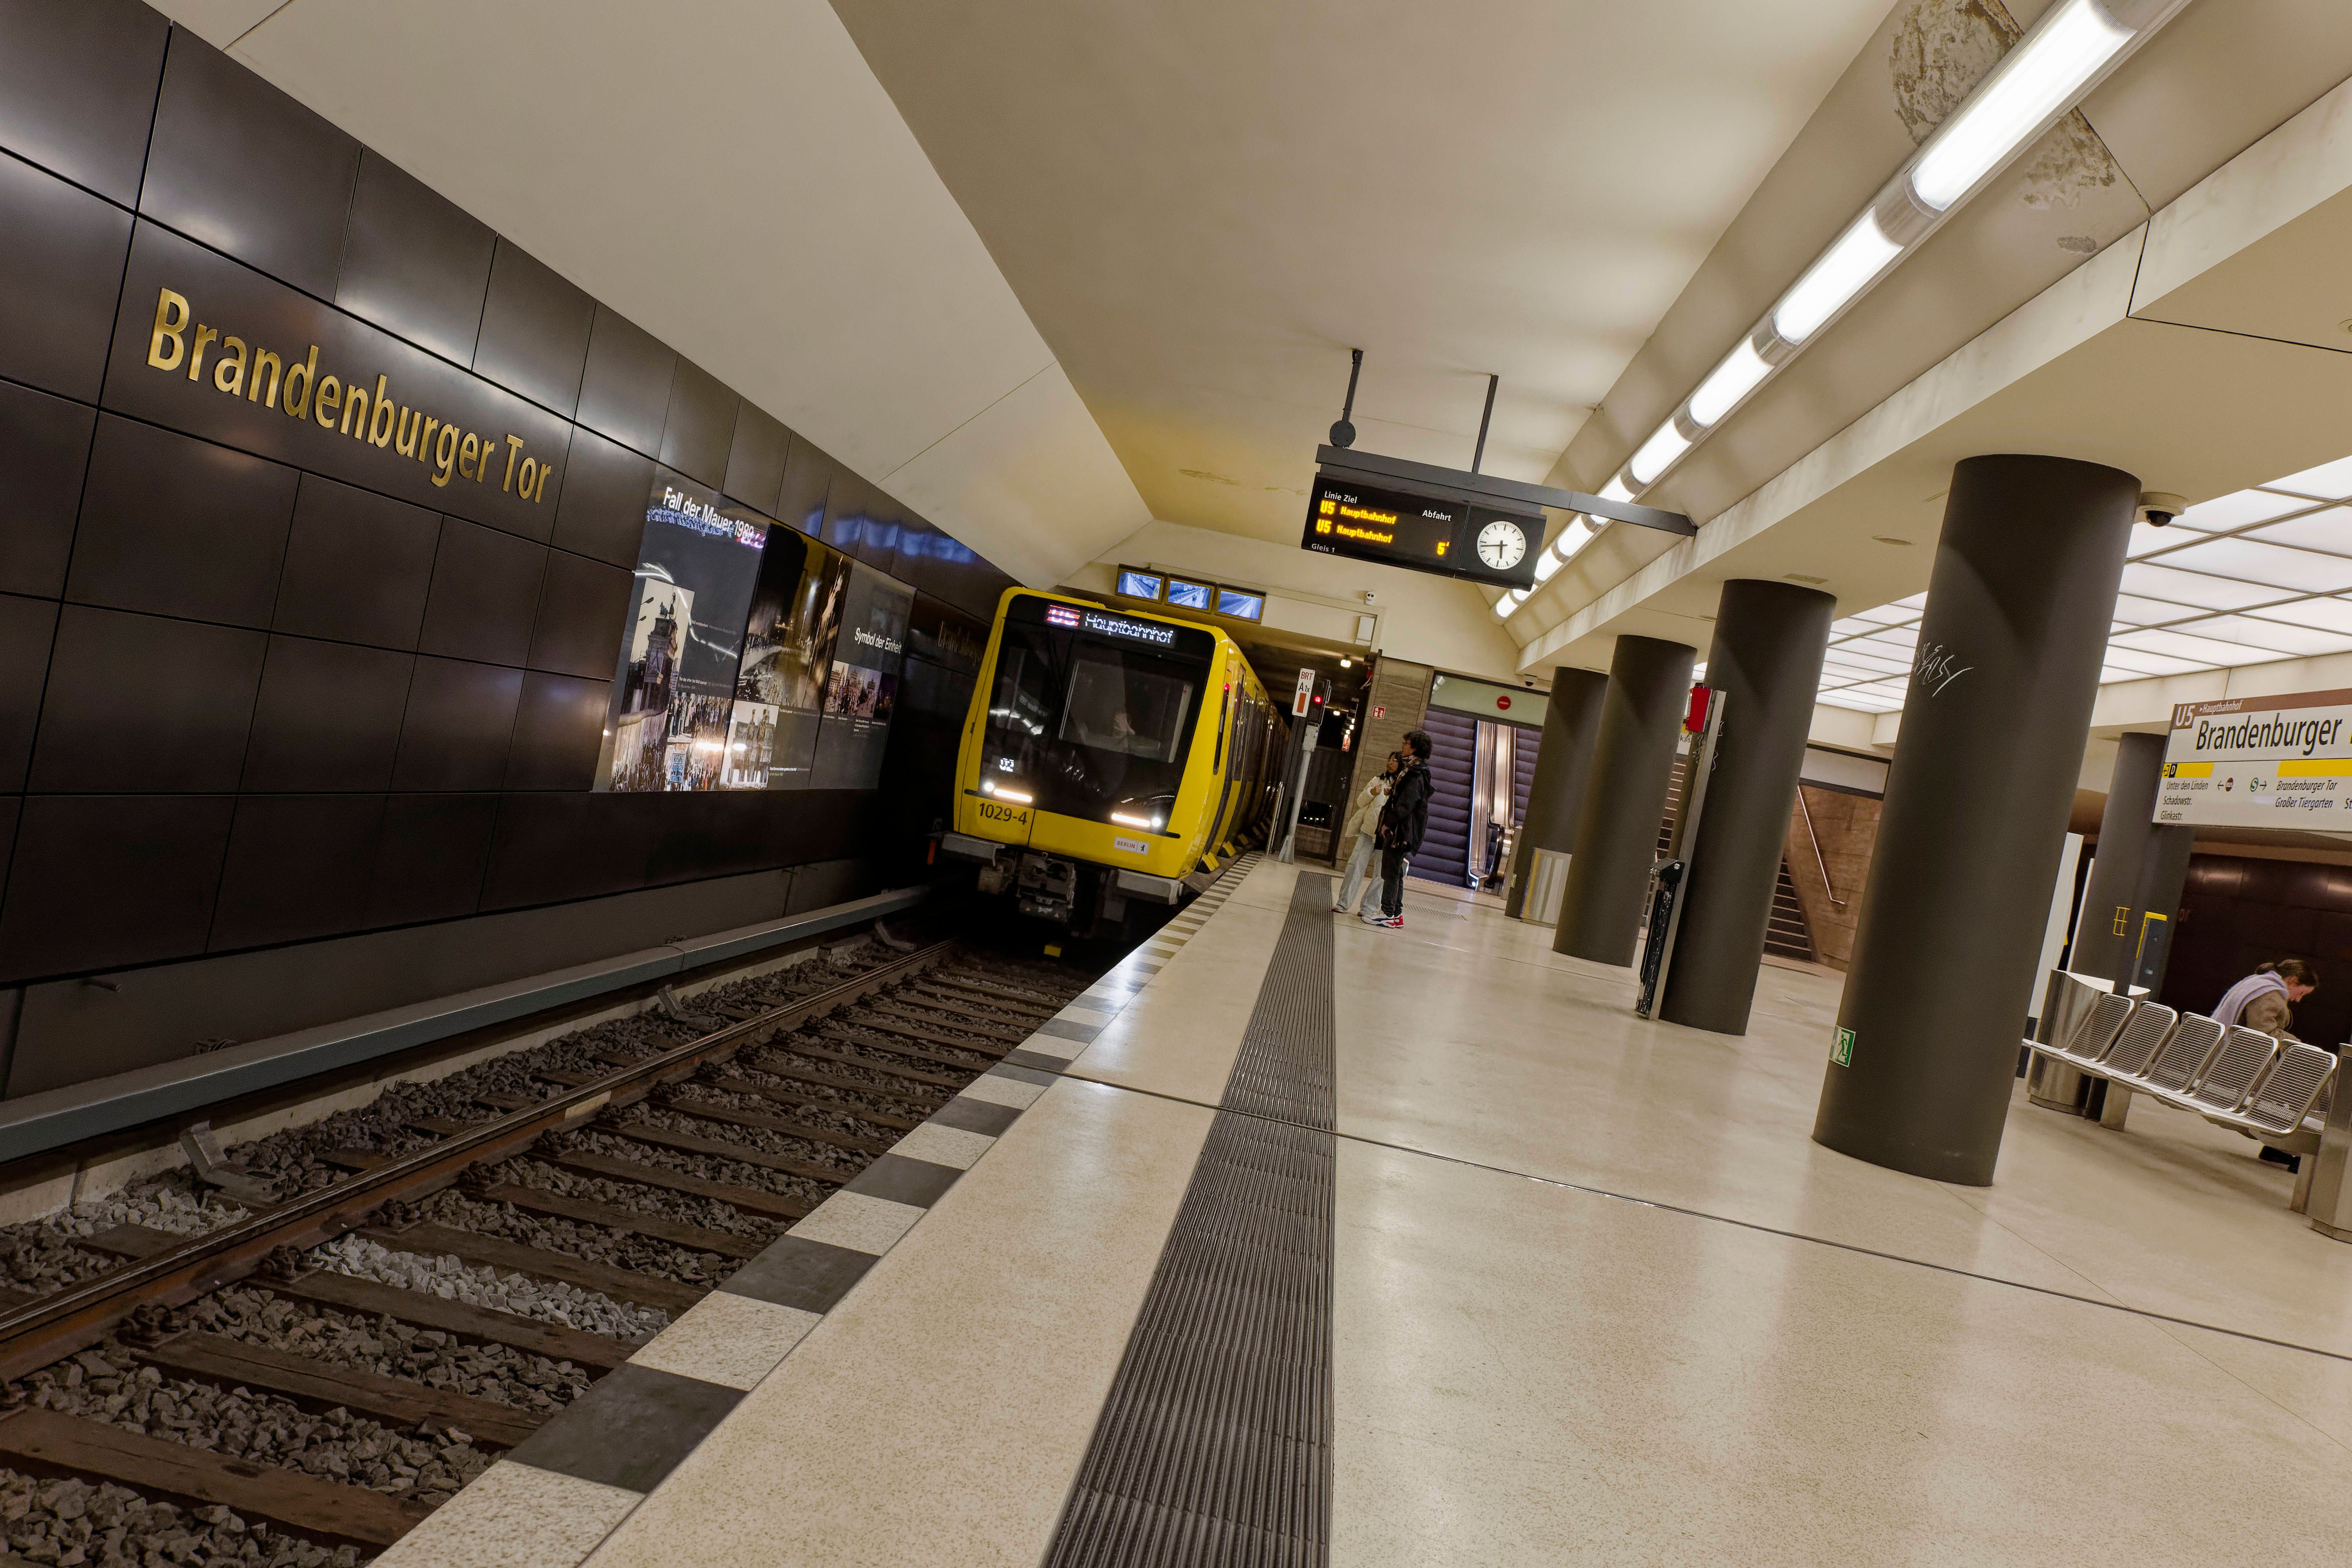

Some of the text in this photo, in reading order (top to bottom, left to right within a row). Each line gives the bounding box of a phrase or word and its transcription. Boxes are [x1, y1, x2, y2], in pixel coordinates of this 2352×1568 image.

[147, 287, 551, 504] Brandenburger Tor
[1324, 491, 1357, 504] Linie Ziel
[663, 486, 683, 511] Fall
[683, 497, 701, 518] der
[702, 504, 733, 532] Mauer
[1320, 500, 1397, 524] U5 Hauptbahnhof
[1422, 510, 1452, 521] Abfahrt
[1316, 519, 1332, 533] U5
[1337, 525, 1393, 543] Hauptbahnhof
[1311, 543, 1329, 552] Gleis
[1085, 613, 1174, 644] Hauptbahnhof
[855, 627, 902, 654] Symbol der Einheit
[1301, 671, 1313, 681] BRT
[2176, 700, 2243, 726] U5 Hauptbahnhof
[2196, 713, 2343, 756] Brandenburger
[2170, 765, 2176, 775] D
[2167, 780, 2209, 790] Unter den Linden
[2276, 779, 2338, 793] Brandenburger Tor
[2163, 795, 2192, 805] Schadowstr.
[2276, 797, 2298, 808] Großer
[2298, 797, 2333, 810] Tiergarten
[980, 803, 1027, 825] 1029-4
[2161, 810, 2183, 820] Glinkastr.
